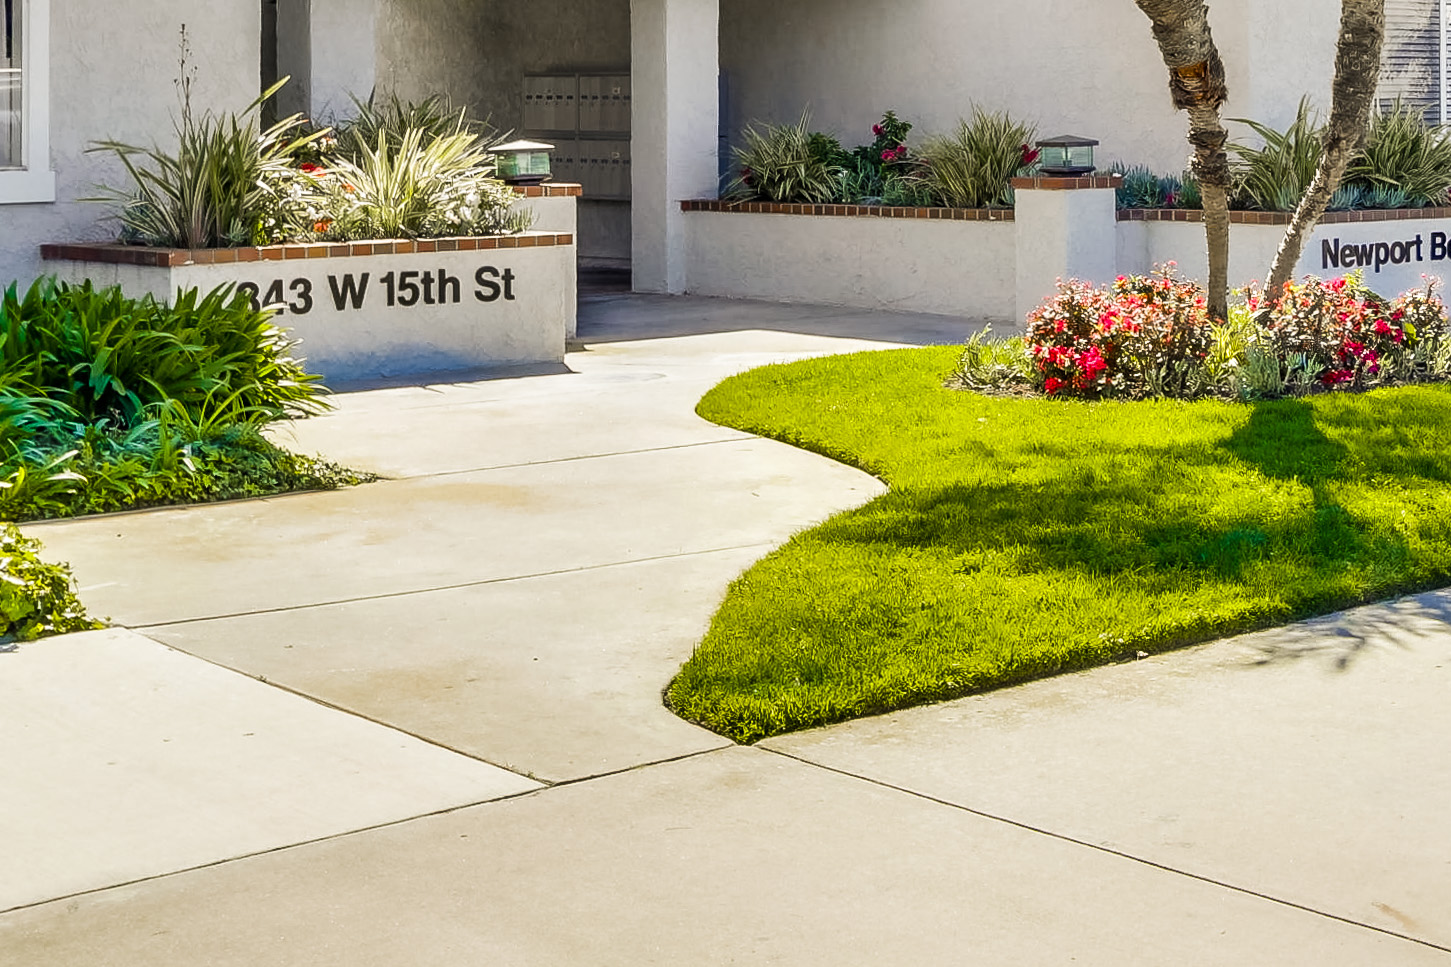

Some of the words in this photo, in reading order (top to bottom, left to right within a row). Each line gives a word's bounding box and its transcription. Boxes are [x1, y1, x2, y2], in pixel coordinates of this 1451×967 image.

[1321, 234, 1423, 273] Newport
[327, 272, 370, 311] W
[379, 268, 461, 307] 15th
[474, 265, 516, 302] St
